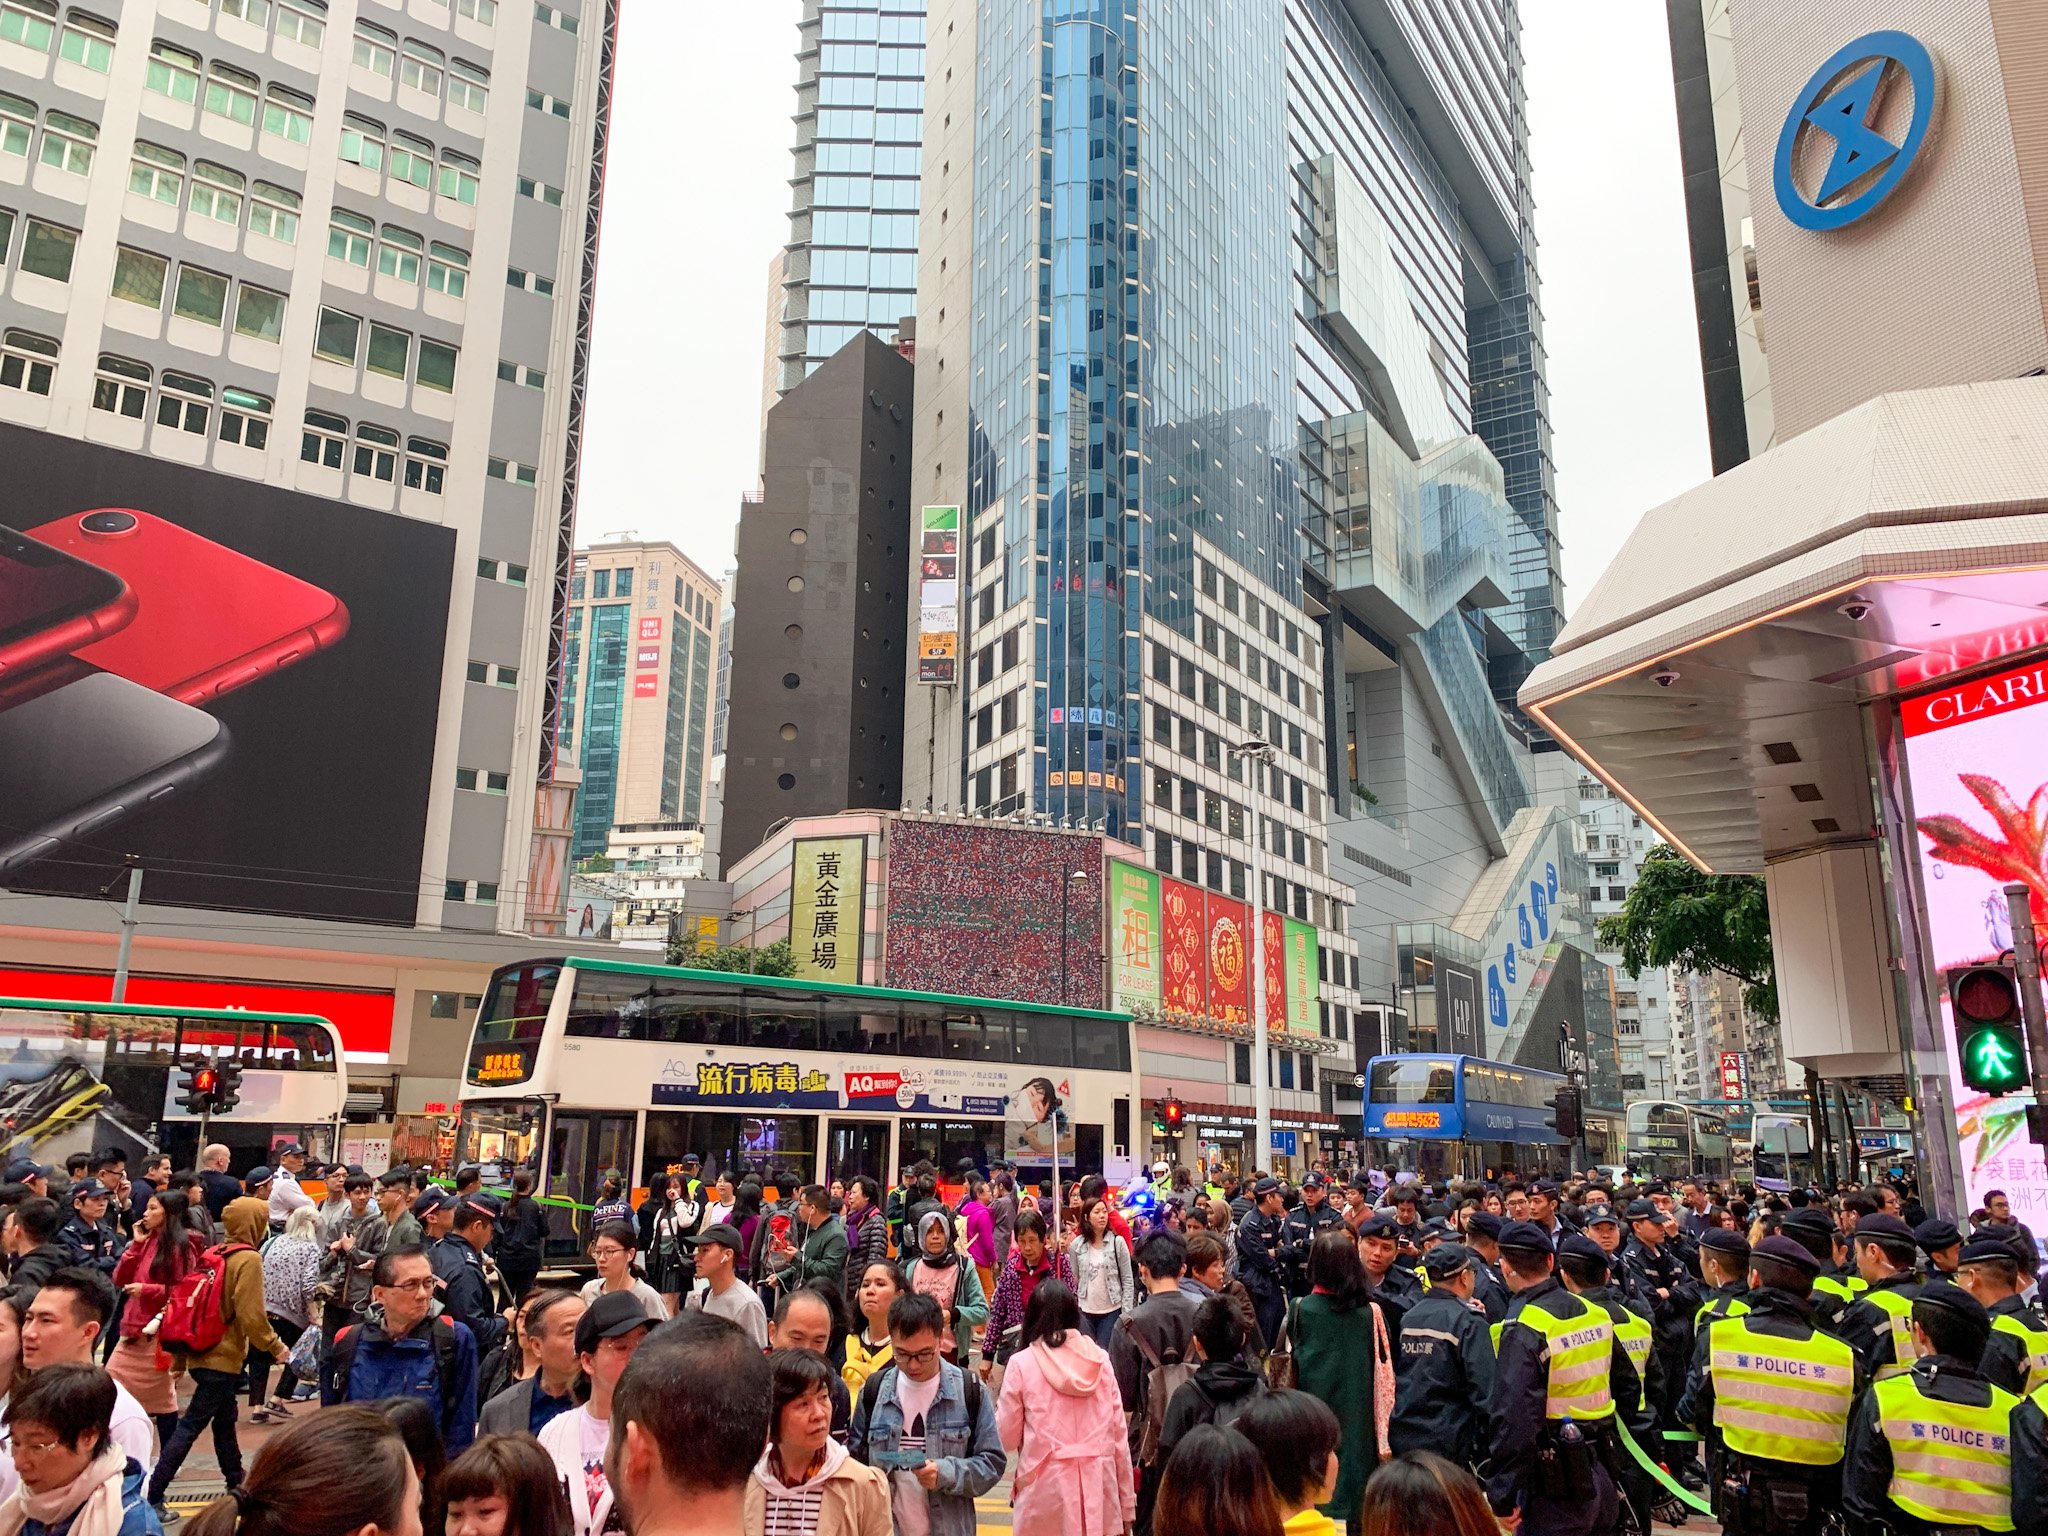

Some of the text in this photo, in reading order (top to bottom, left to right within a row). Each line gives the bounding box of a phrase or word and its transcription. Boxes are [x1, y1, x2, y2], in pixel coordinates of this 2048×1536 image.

[646, 561, 661, 610] 利舞臺
[641, 628, 659, 638] QLO
[642, 620, 658, 628] UNI
[639, 653, 658, 662] MUJI
[1926, 668, 2048, 723] CLARI
[812, 852, 841, 970] 黃金廣場
[1122, 907, 1150, 968] 租
[1218, 935, 1237, 974] 福
[1119, 973, 1153, 992] FOR LEASE
[1454, 998, 1470, 1035] GAP
[563, 1043, 581, 1051] 5580
[698, 1063, 799, 1096] 流行病毒
[1486, 1114, 1514, 1130] CALVIN KLEIN
[1661, 1137, 1677, 1147] 671
[1571, 1329, 1595, 1346] POLICE
[1622, 1341, 1639, 1351] OLICE
[1737, 1354, 1826, 1379] 警 POLICE 察
[1911, 1423, 2006, 1451] 警 POLICE 察
